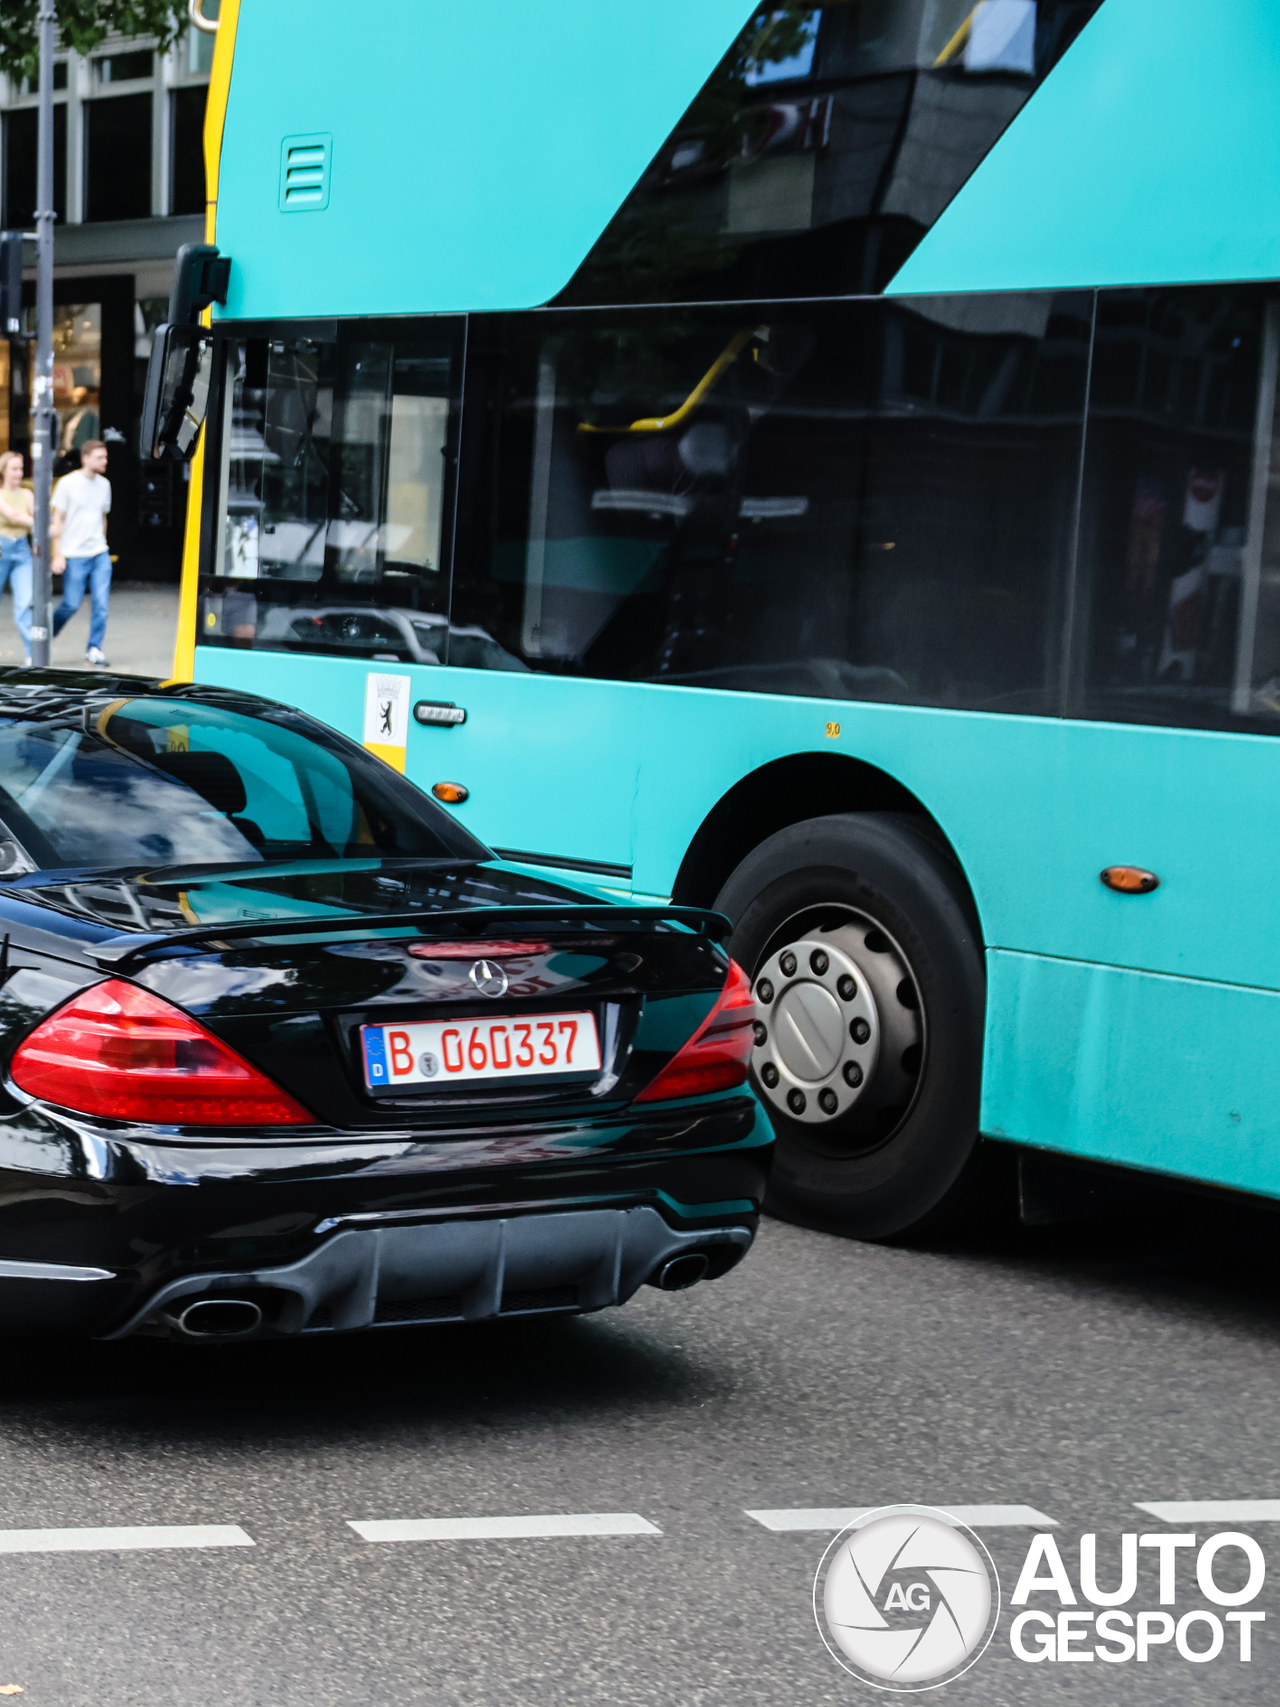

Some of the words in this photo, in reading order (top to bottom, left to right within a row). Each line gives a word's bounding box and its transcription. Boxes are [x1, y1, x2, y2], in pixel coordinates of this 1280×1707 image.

[389, 1031, 414, 1075] B
[441, 1020, 578, 1073] 060337
[372, 1063, 384, 1077] D
